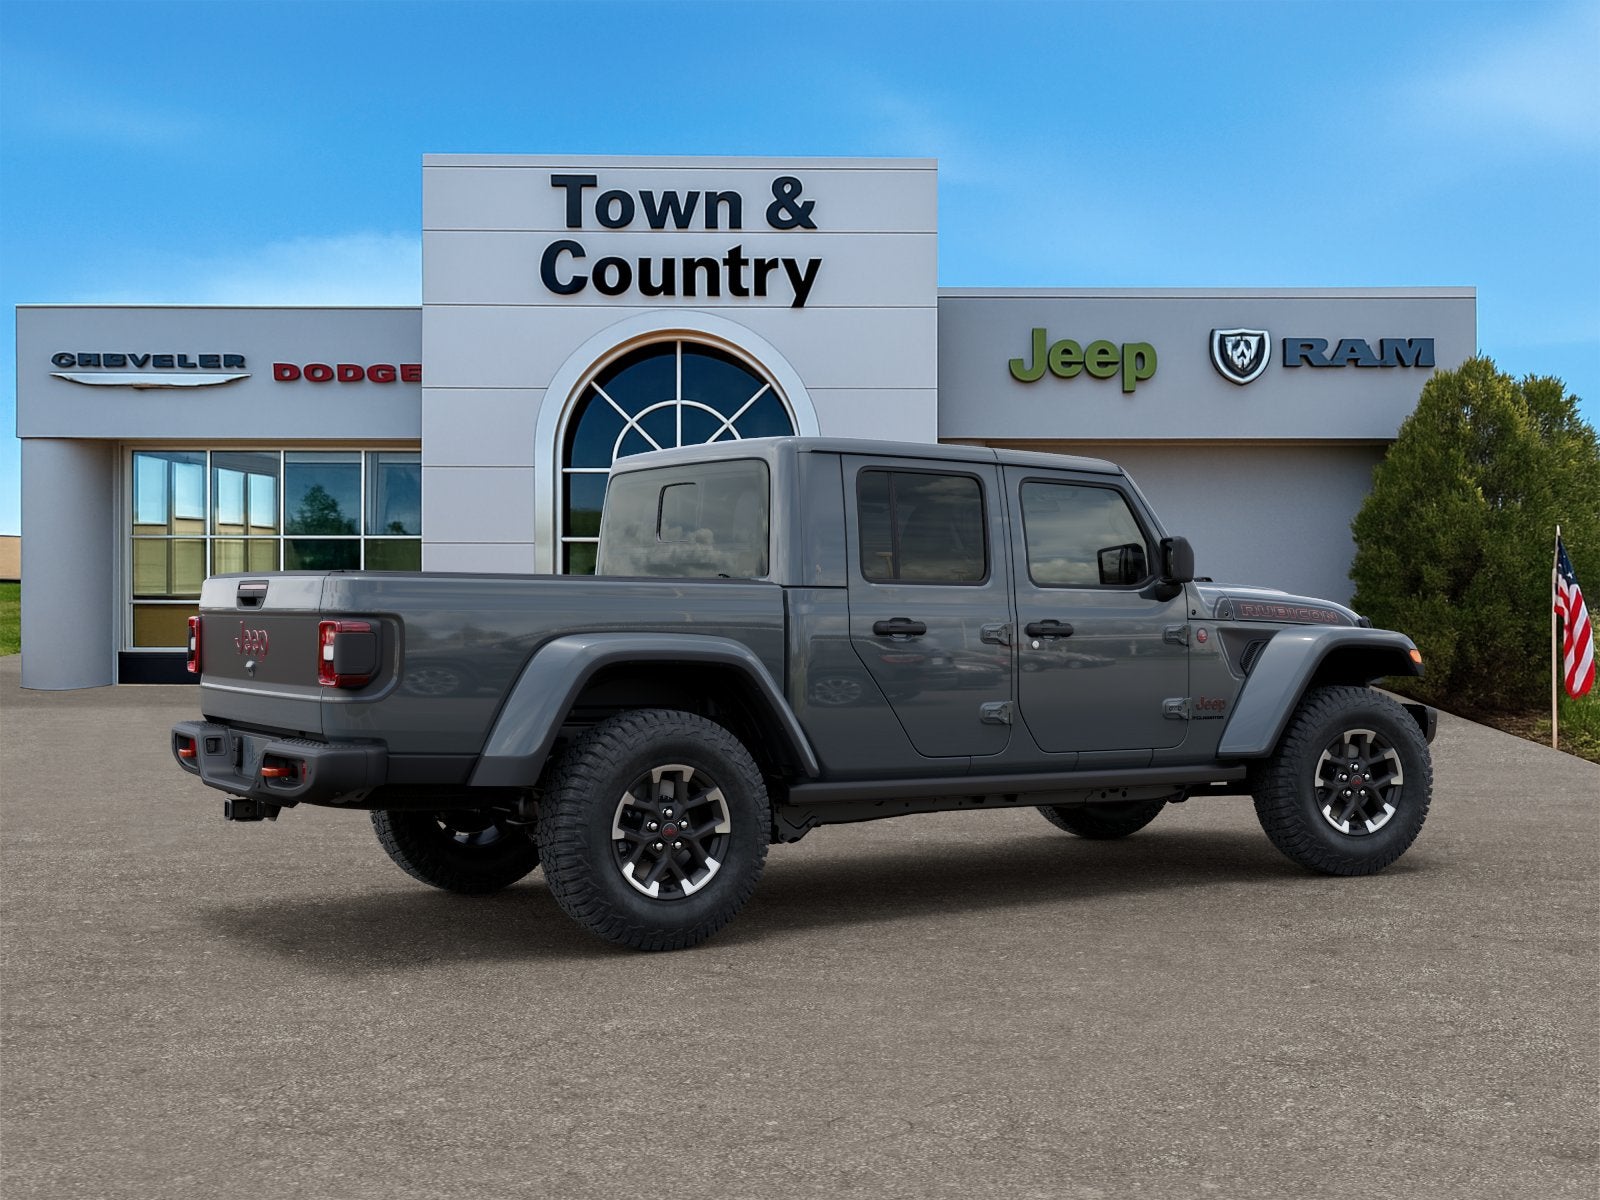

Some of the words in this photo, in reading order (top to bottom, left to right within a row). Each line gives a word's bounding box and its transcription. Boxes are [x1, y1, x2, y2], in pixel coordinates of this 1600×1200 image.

[550, 174, 743, 230] Town
[765, 176, 818, 230] &
[540, 239, 822, 308] Country
[1008, 327, 1157, 392] Jeep
[1282, 337, 1435, 368] RAM
[273, 363, 422, 383] DODGE
[1241, 603, 1338, 623] RUBICON
[1196, 696, 1226, 712] Jeep
